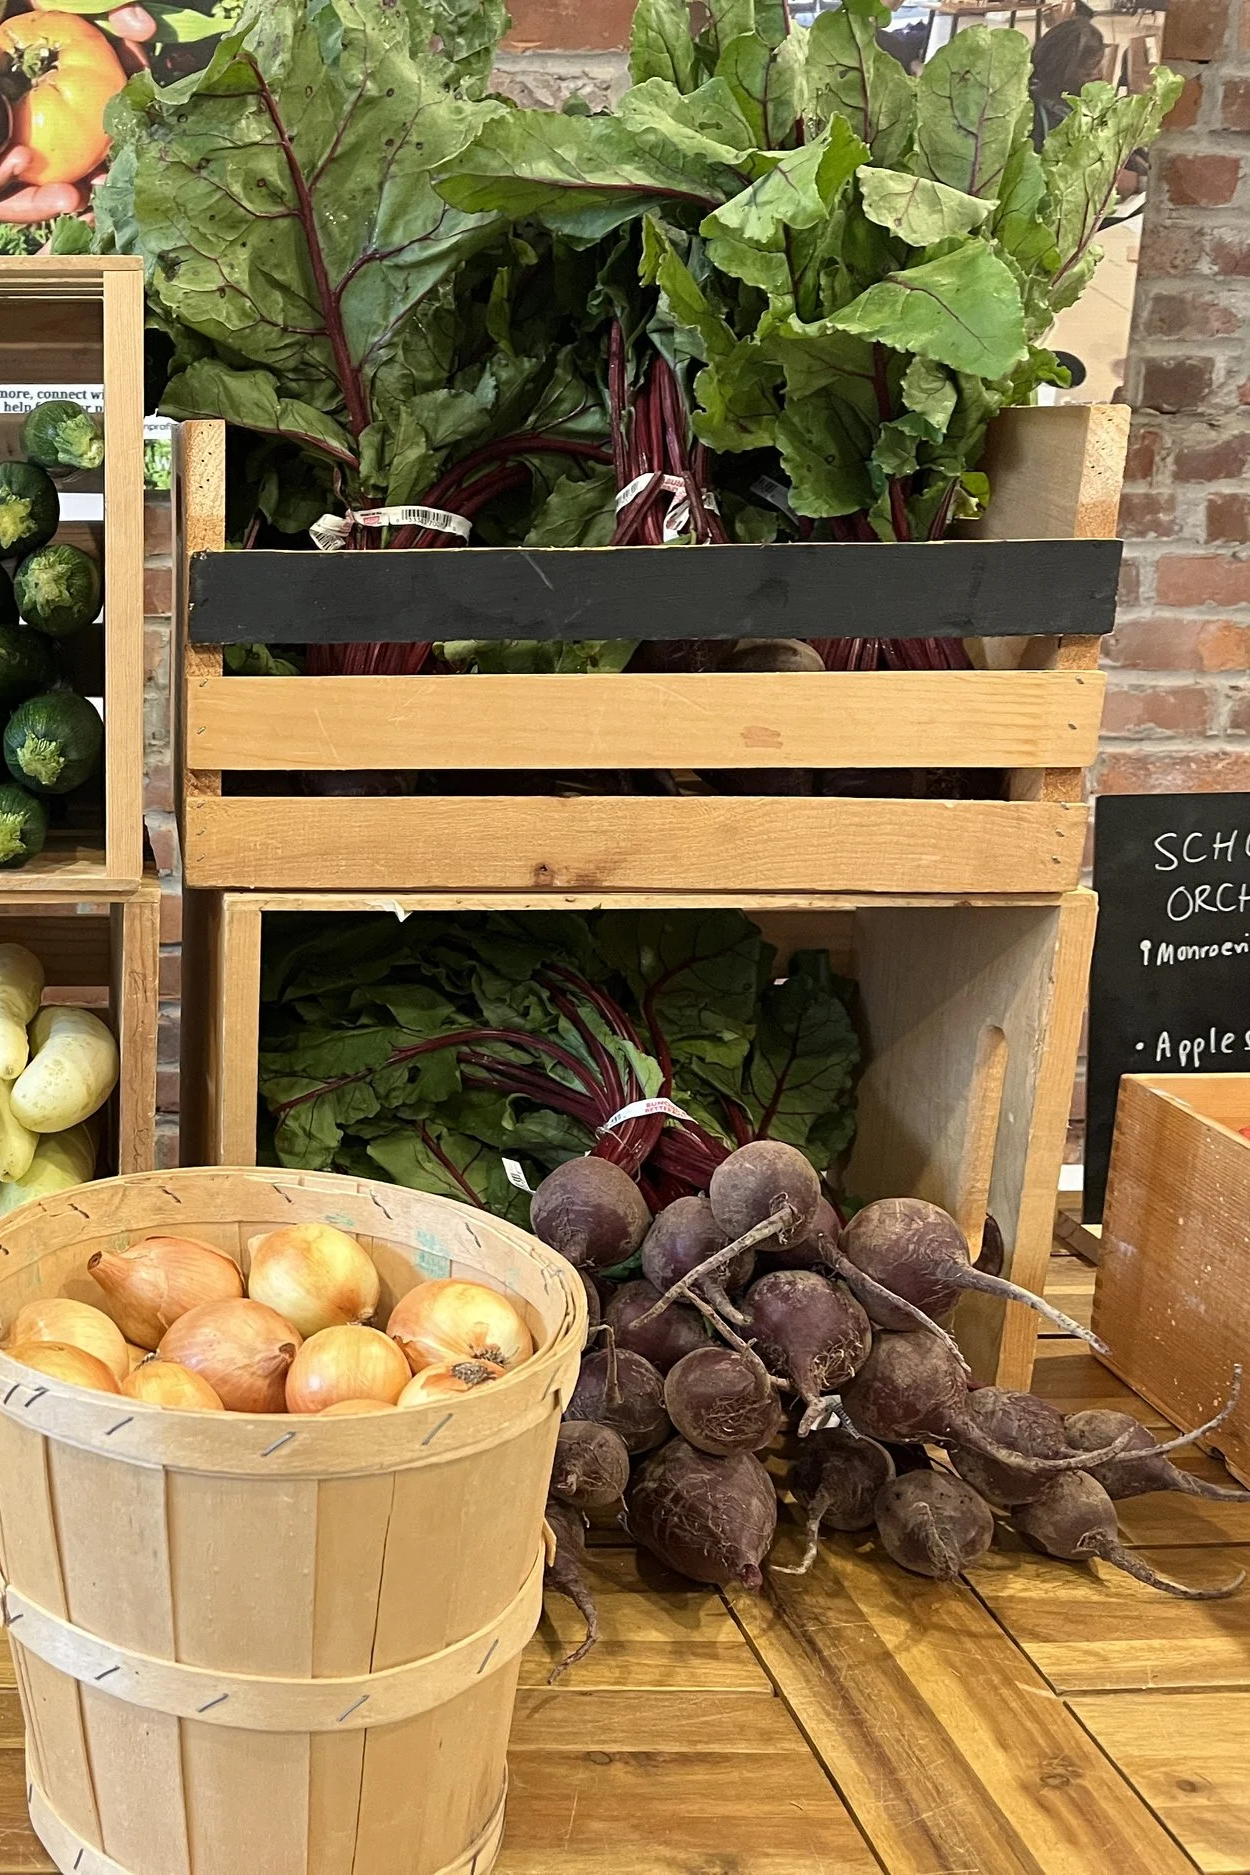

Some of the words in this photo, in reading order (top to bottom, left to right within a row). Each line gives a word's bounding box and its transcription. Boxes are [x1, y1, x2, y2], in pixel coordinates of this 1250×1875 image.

[36, 388, 87, 400] connect
[4, 401, 33, 413] help
[1154, 829, 1250, 872] SCH
